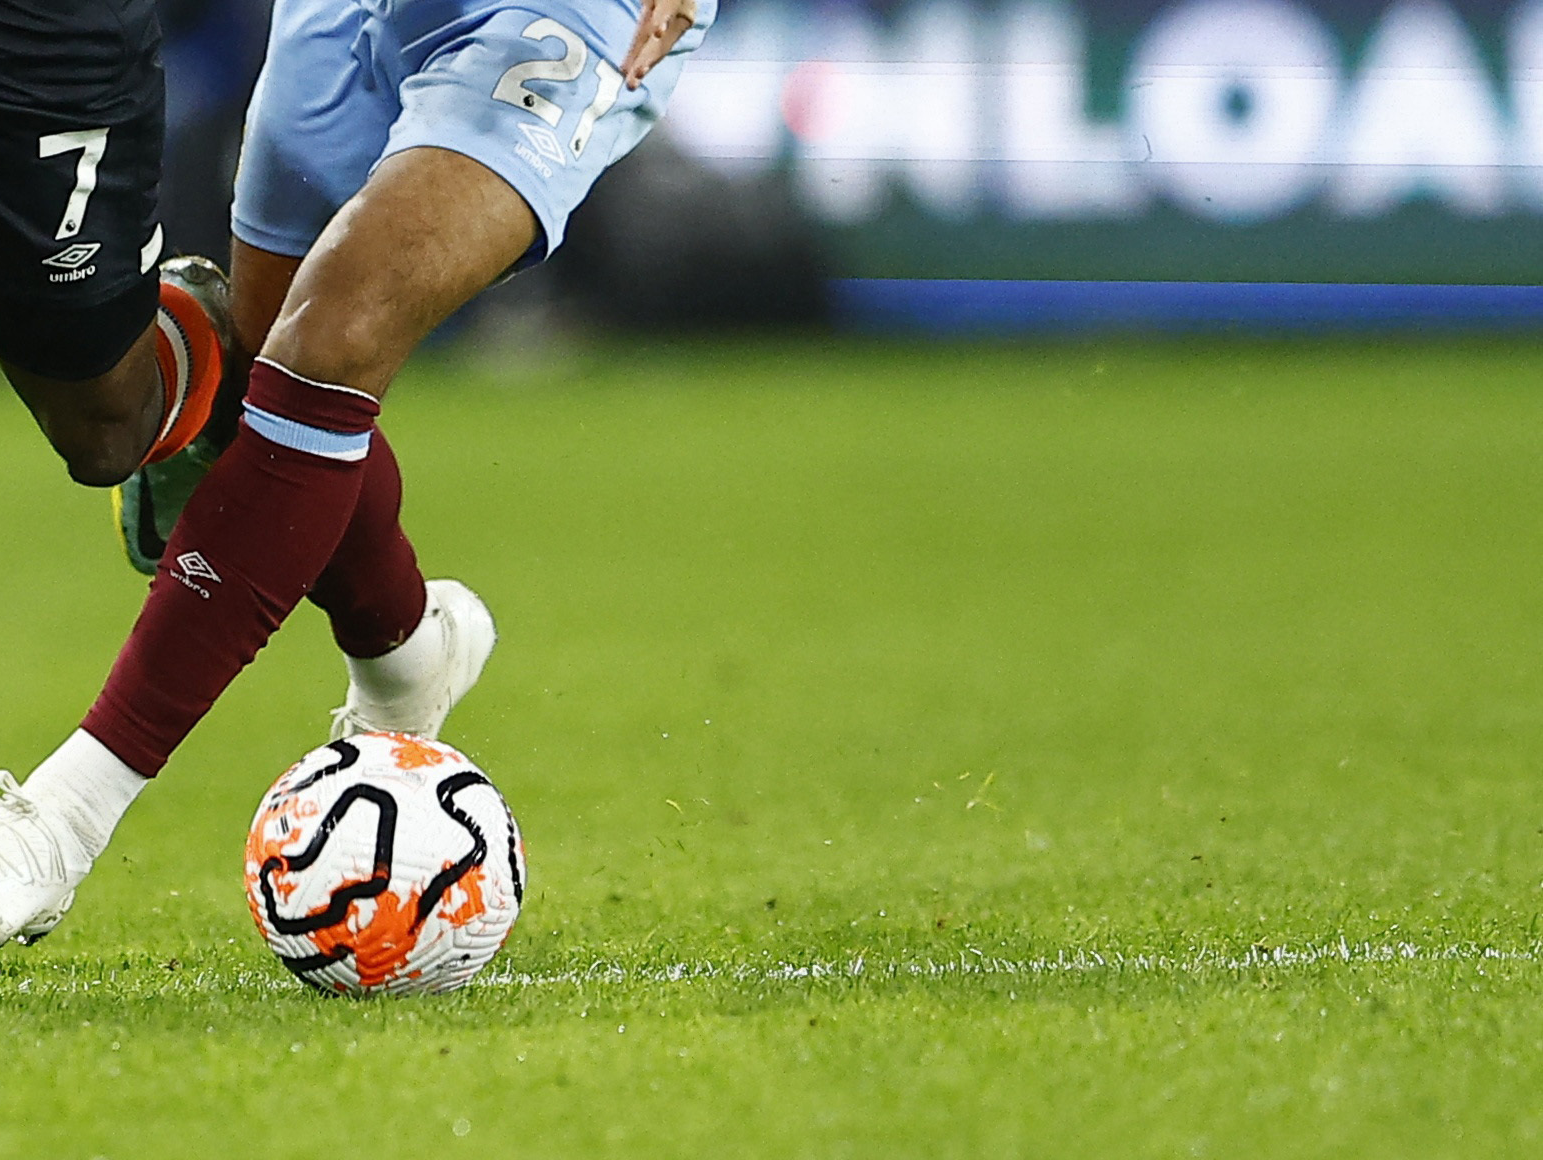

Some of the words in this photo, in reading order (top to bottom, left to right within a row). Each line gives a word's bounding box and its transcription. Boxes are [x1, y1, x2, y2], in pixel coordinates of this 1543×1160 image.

[513, 142, 554, 179] umbro
[39, 126, 111, 241] 7
[49, 265, 96, 283] umbro
[169, 569, 210, 599] umbro
